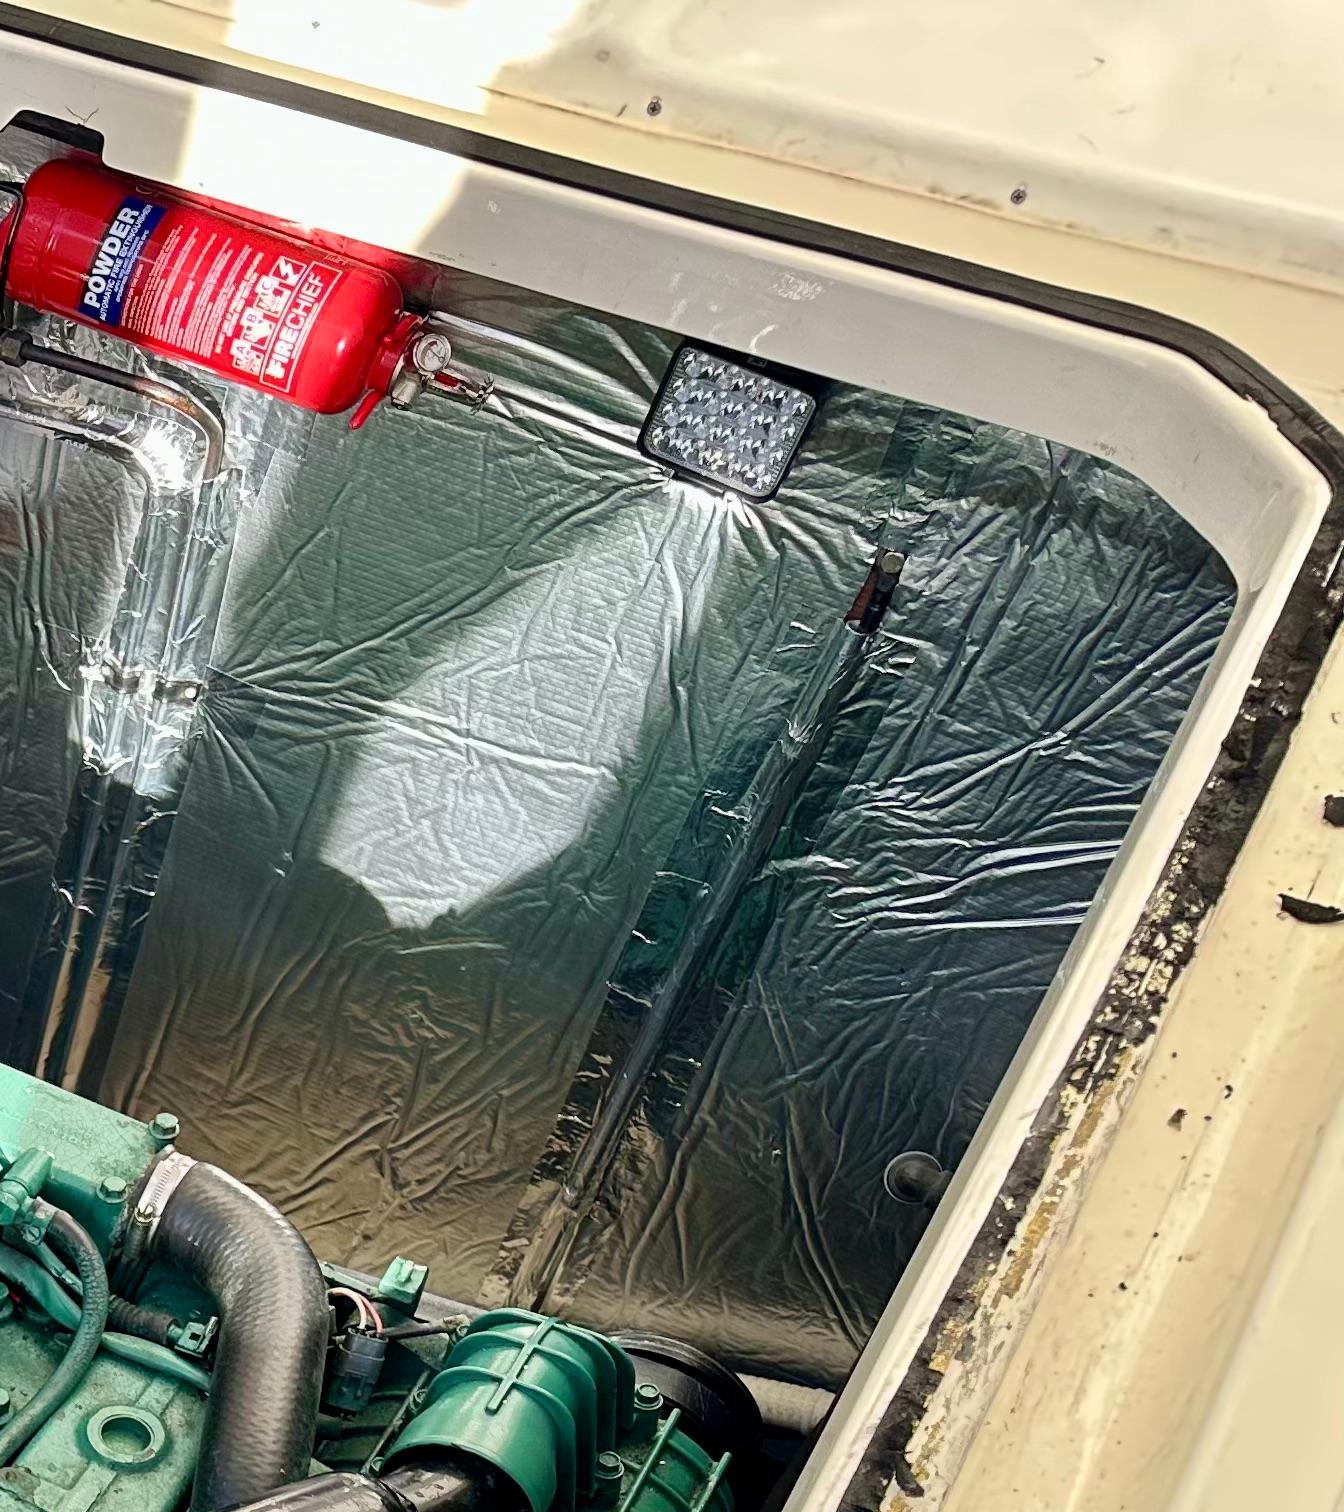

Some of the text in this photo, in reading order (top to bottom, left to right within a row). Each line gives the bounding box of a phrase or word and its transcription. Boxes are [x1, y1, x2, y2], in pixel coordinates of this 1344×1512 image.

[83, 207, 140, 309] POWDER
[99, 278, 115, 321] AUTOMATIC
[112, 258, 124, 278] FIRE
[236, 345, 246, 354] A
[247, 313, 257, 323] B
[266, 272, 324, 371] FIRECHIEF
